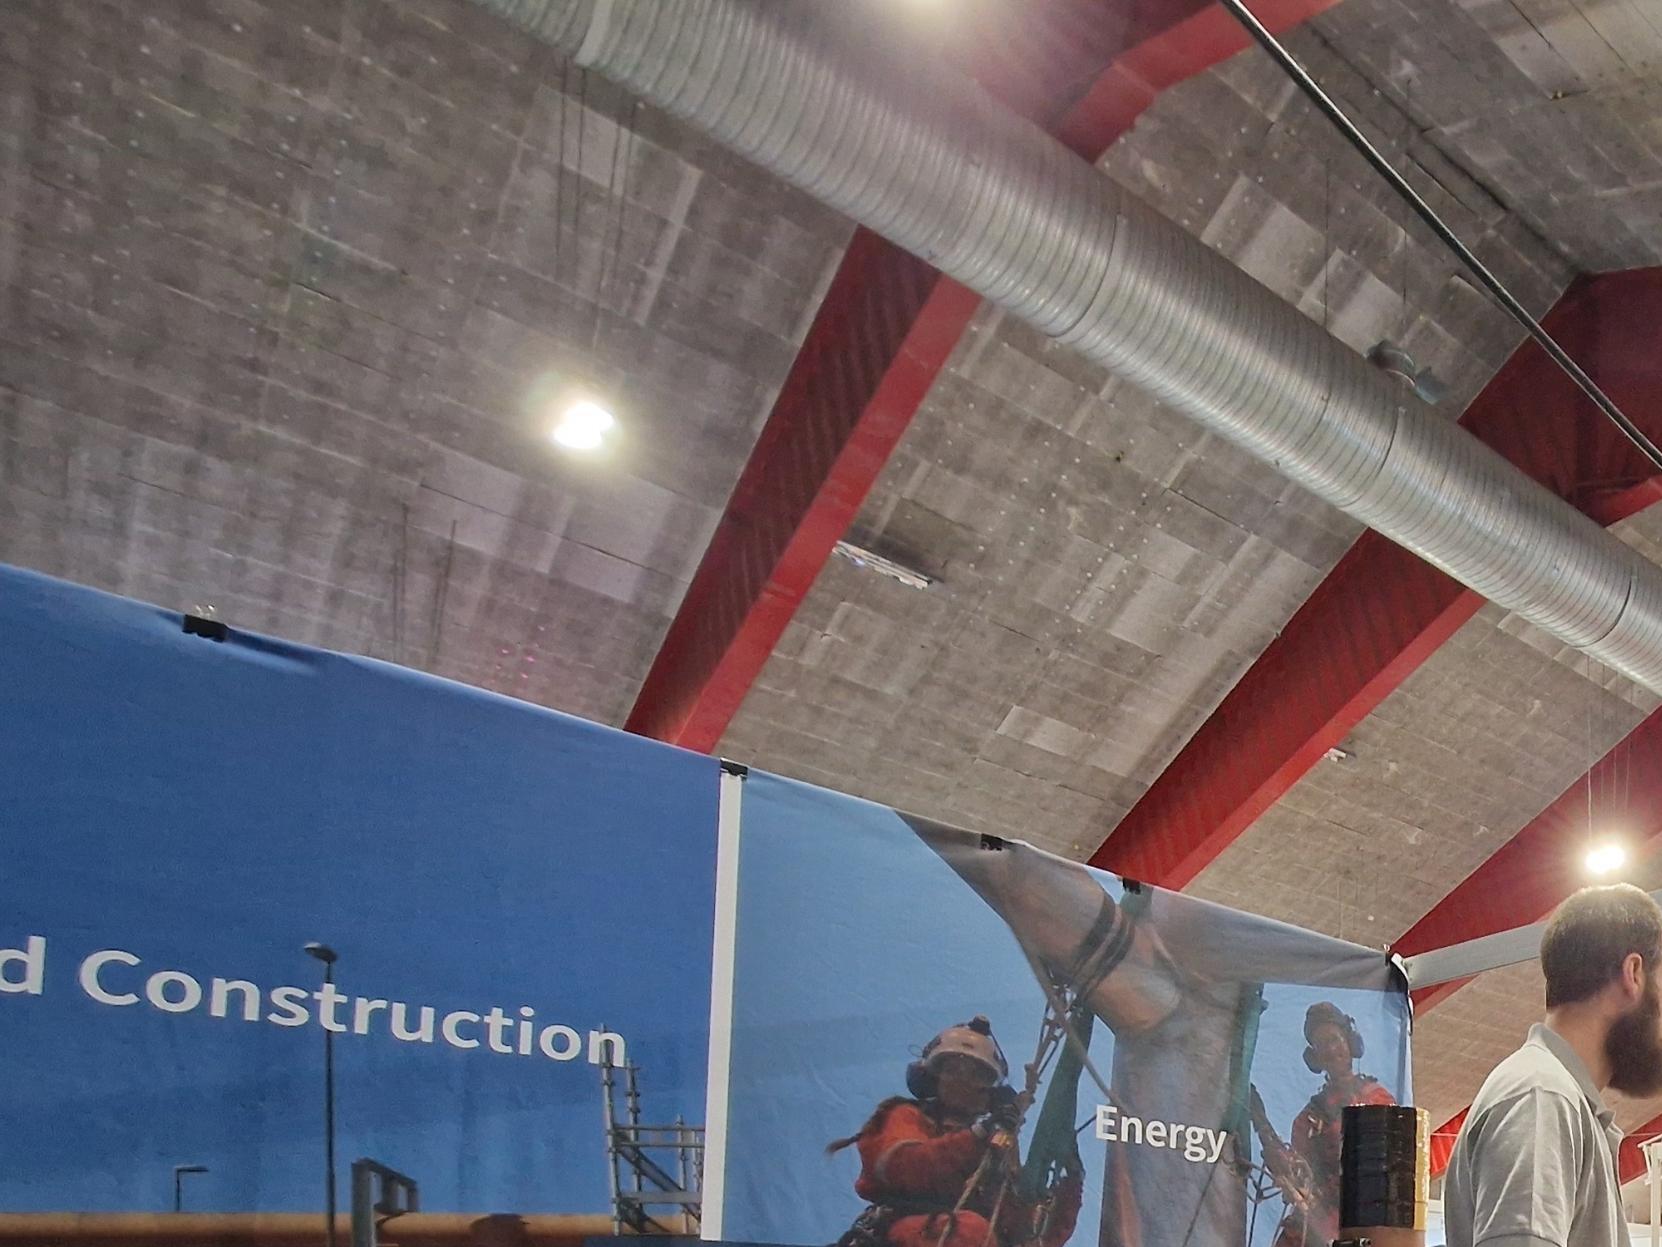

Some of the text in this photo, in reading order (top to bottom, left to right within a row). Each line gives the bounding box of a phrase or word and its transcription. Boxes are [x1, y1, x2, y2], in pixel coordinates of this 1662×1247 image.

[0, 935, 626, 1067] d Construction
[1095, 1105, 1227, 1163] Energy
